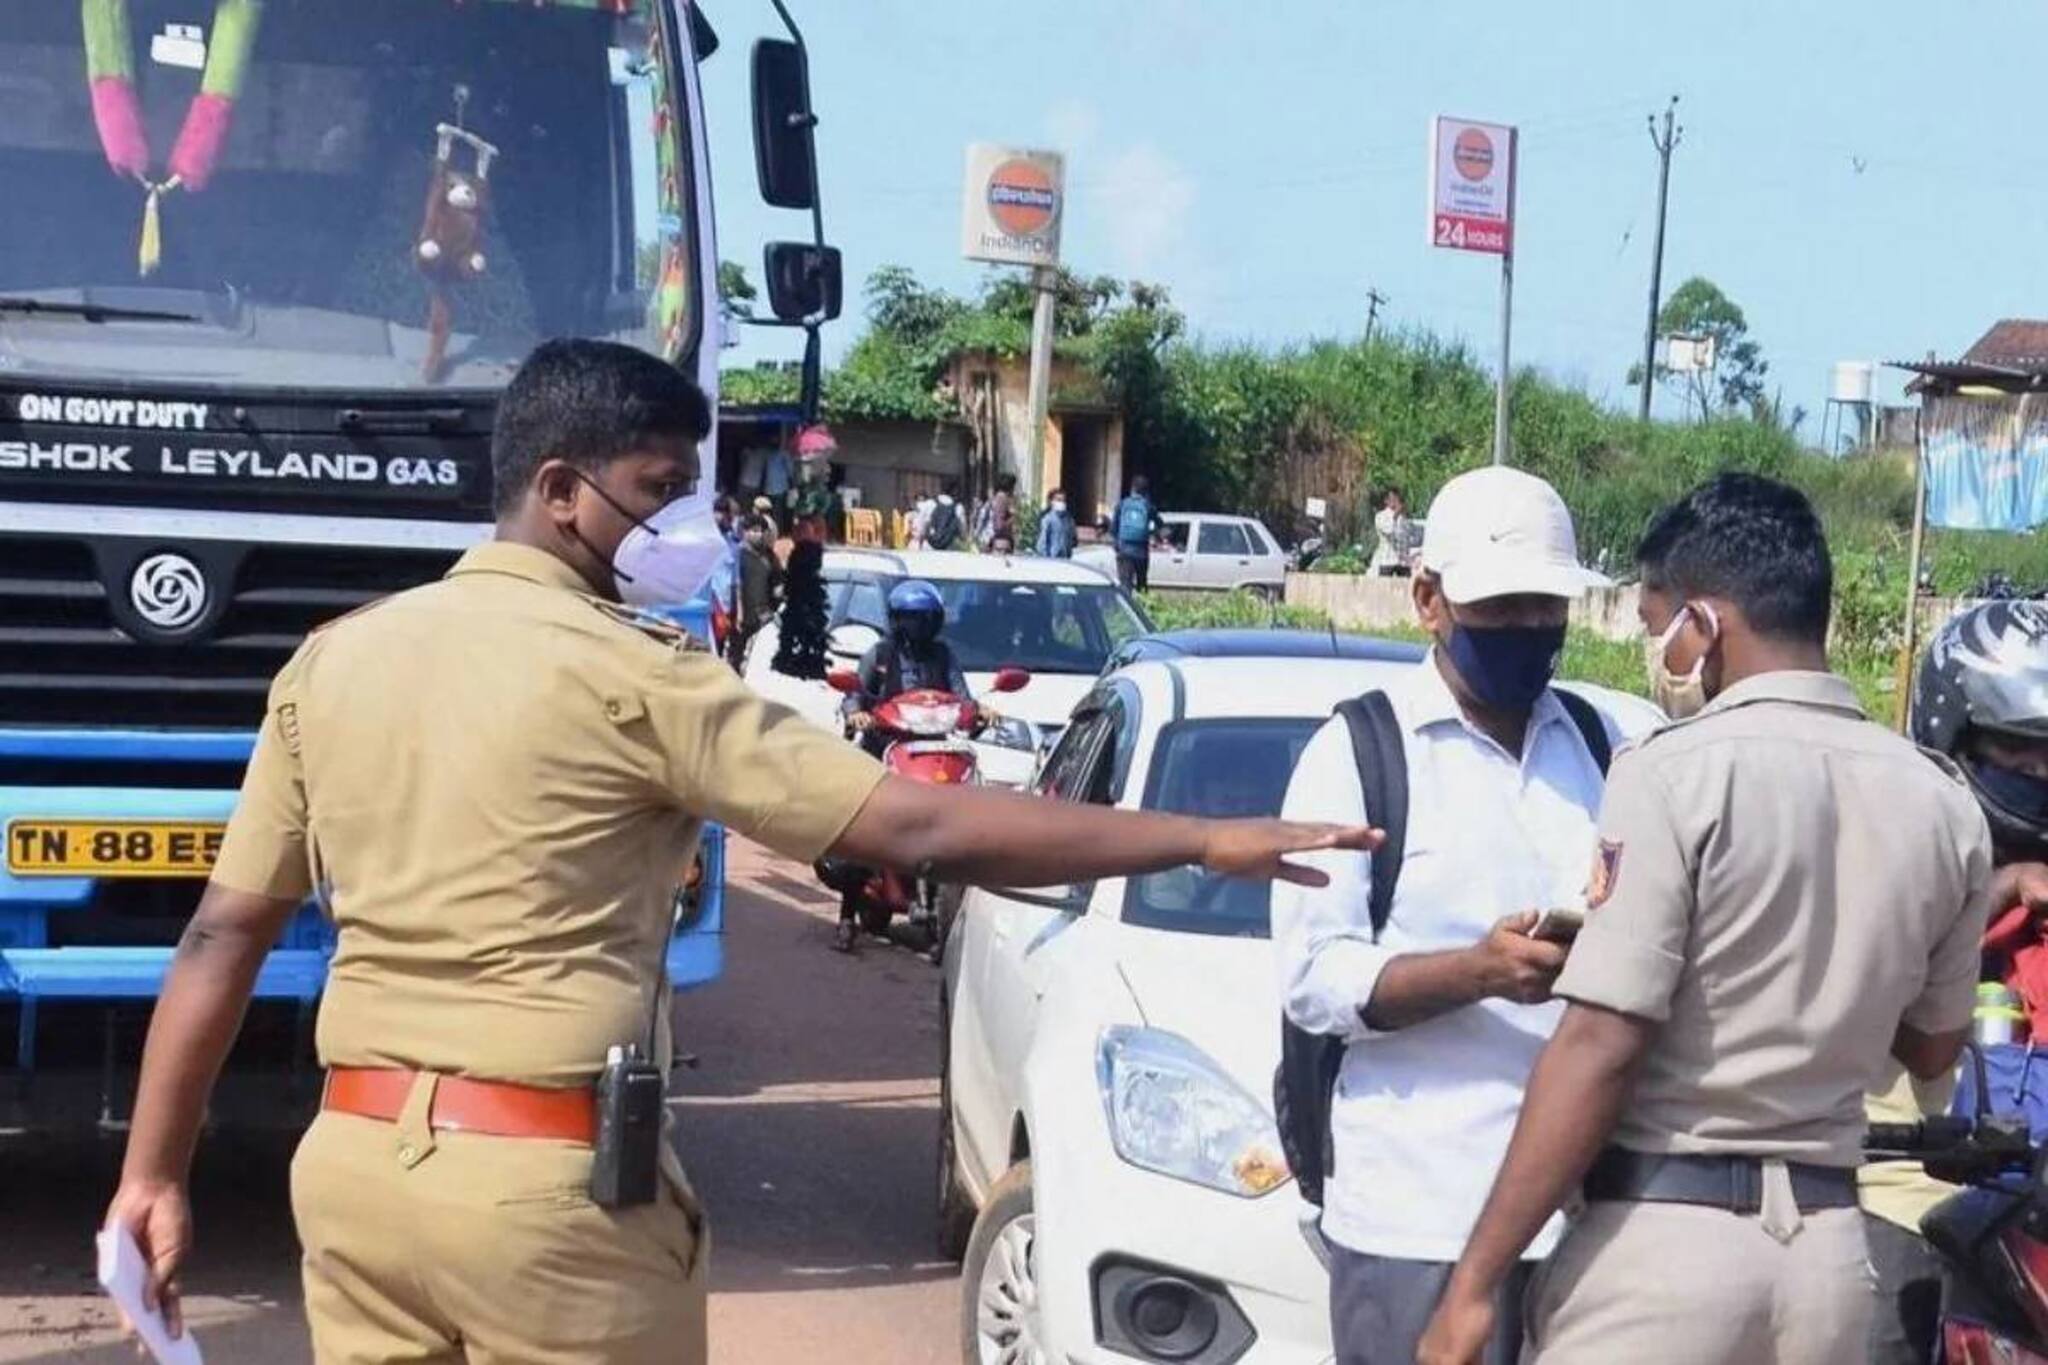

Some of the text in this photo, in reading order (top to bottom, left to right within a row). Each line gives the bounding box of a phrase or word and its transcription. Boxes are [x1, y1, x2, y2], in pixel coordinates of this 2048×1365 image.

[1437, 219, 1466, 244] 24
[20, 394, 208, 429] ON GOVT DUTY
[0, 441, 458, 485] SHOK LEYLAND GAS
[15, 829, 67, 862] TN
[92, 831, 154, 862] 88
